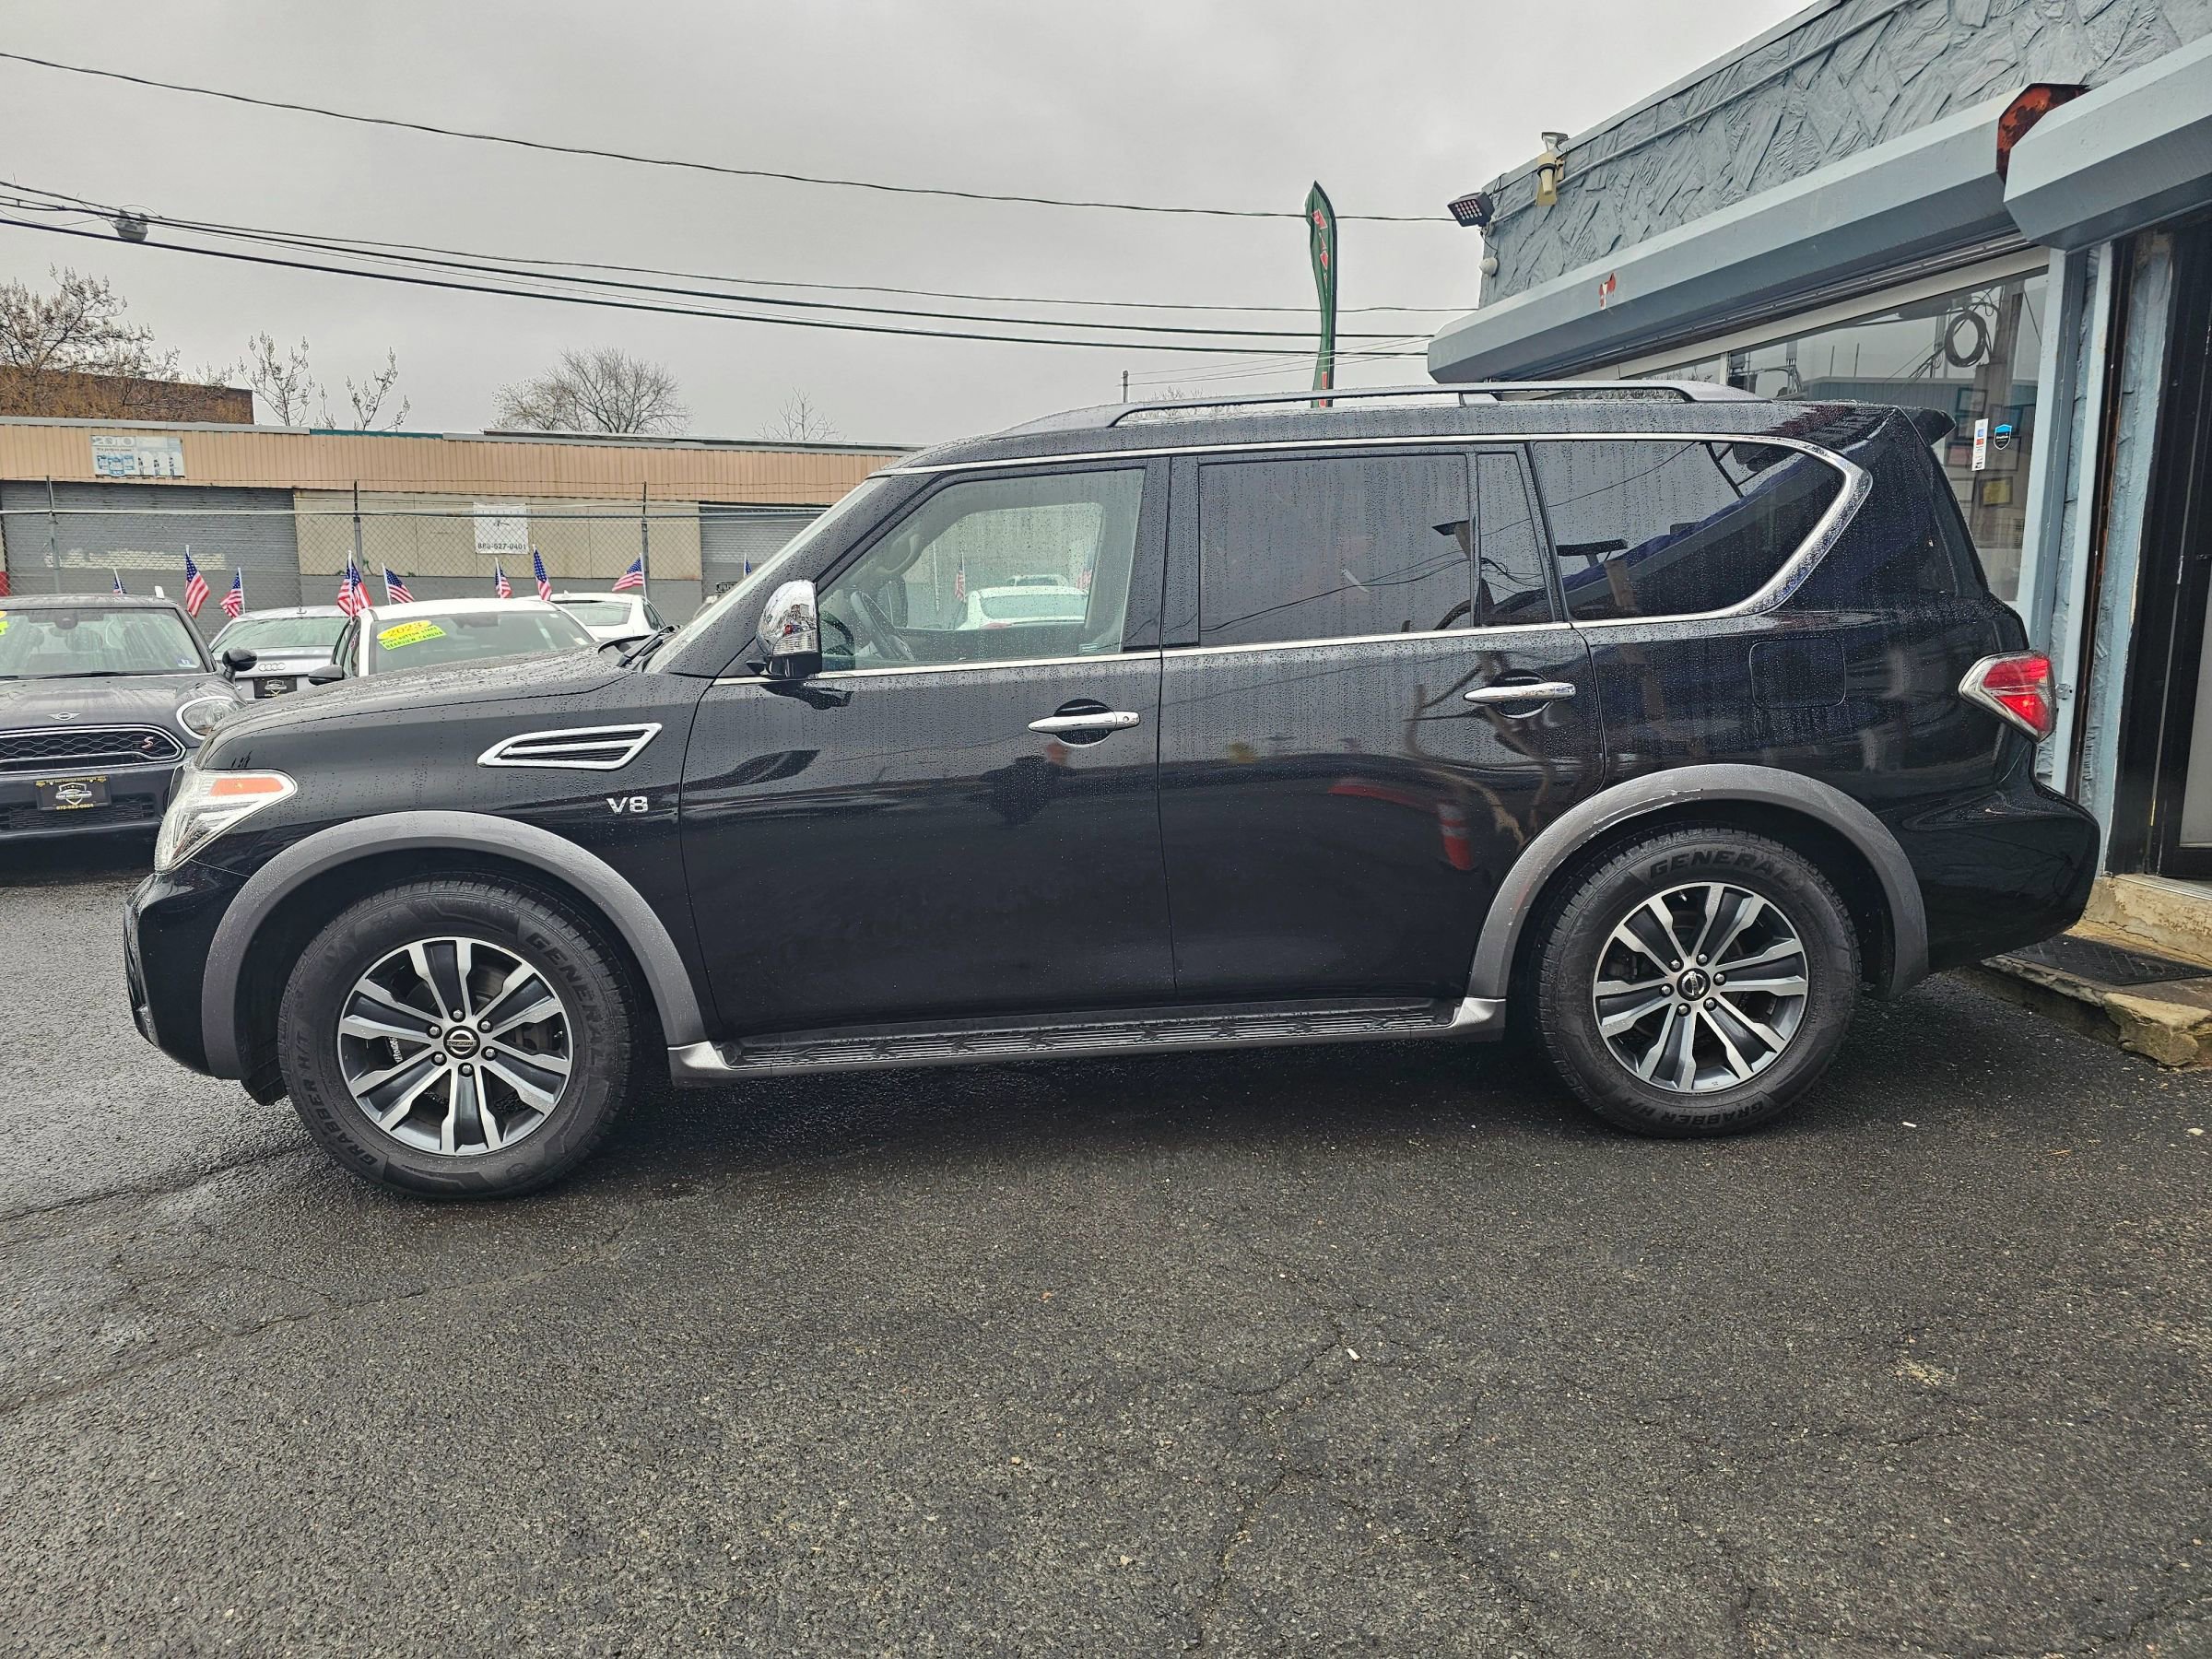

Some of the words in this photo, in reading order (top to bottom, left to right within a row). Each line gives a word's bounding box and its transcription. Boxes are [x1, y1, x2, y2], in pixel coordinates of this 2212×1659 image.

[606, 796, 648, 815] V8
[1650, 850, 1790, 888] GENERAL
[302, 1078, 378, 1166] GRABBER
[1660, 1100, 1764, 1125] GRABBER
